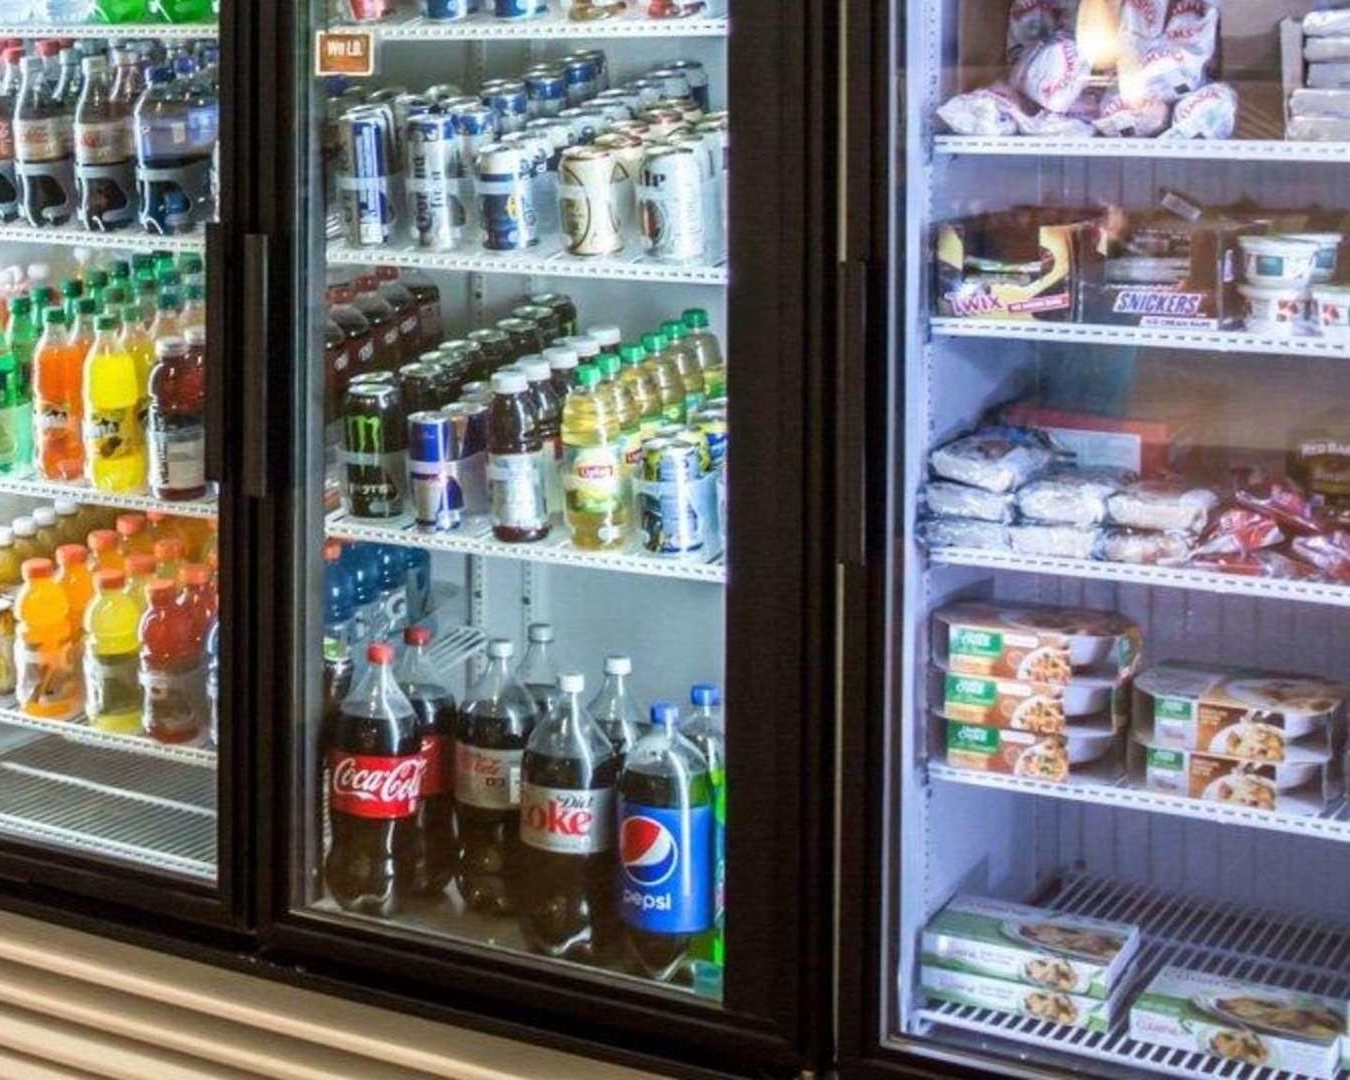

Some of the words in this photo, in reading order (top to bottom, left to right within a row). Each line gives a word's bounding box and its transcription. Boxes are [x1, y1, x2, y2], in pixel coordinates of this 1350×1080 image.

[1117, 293, 1198, 313] SNICKERS
[557, 794, 593, 809] Diet
[623, 888, 672, 911] pepsi
